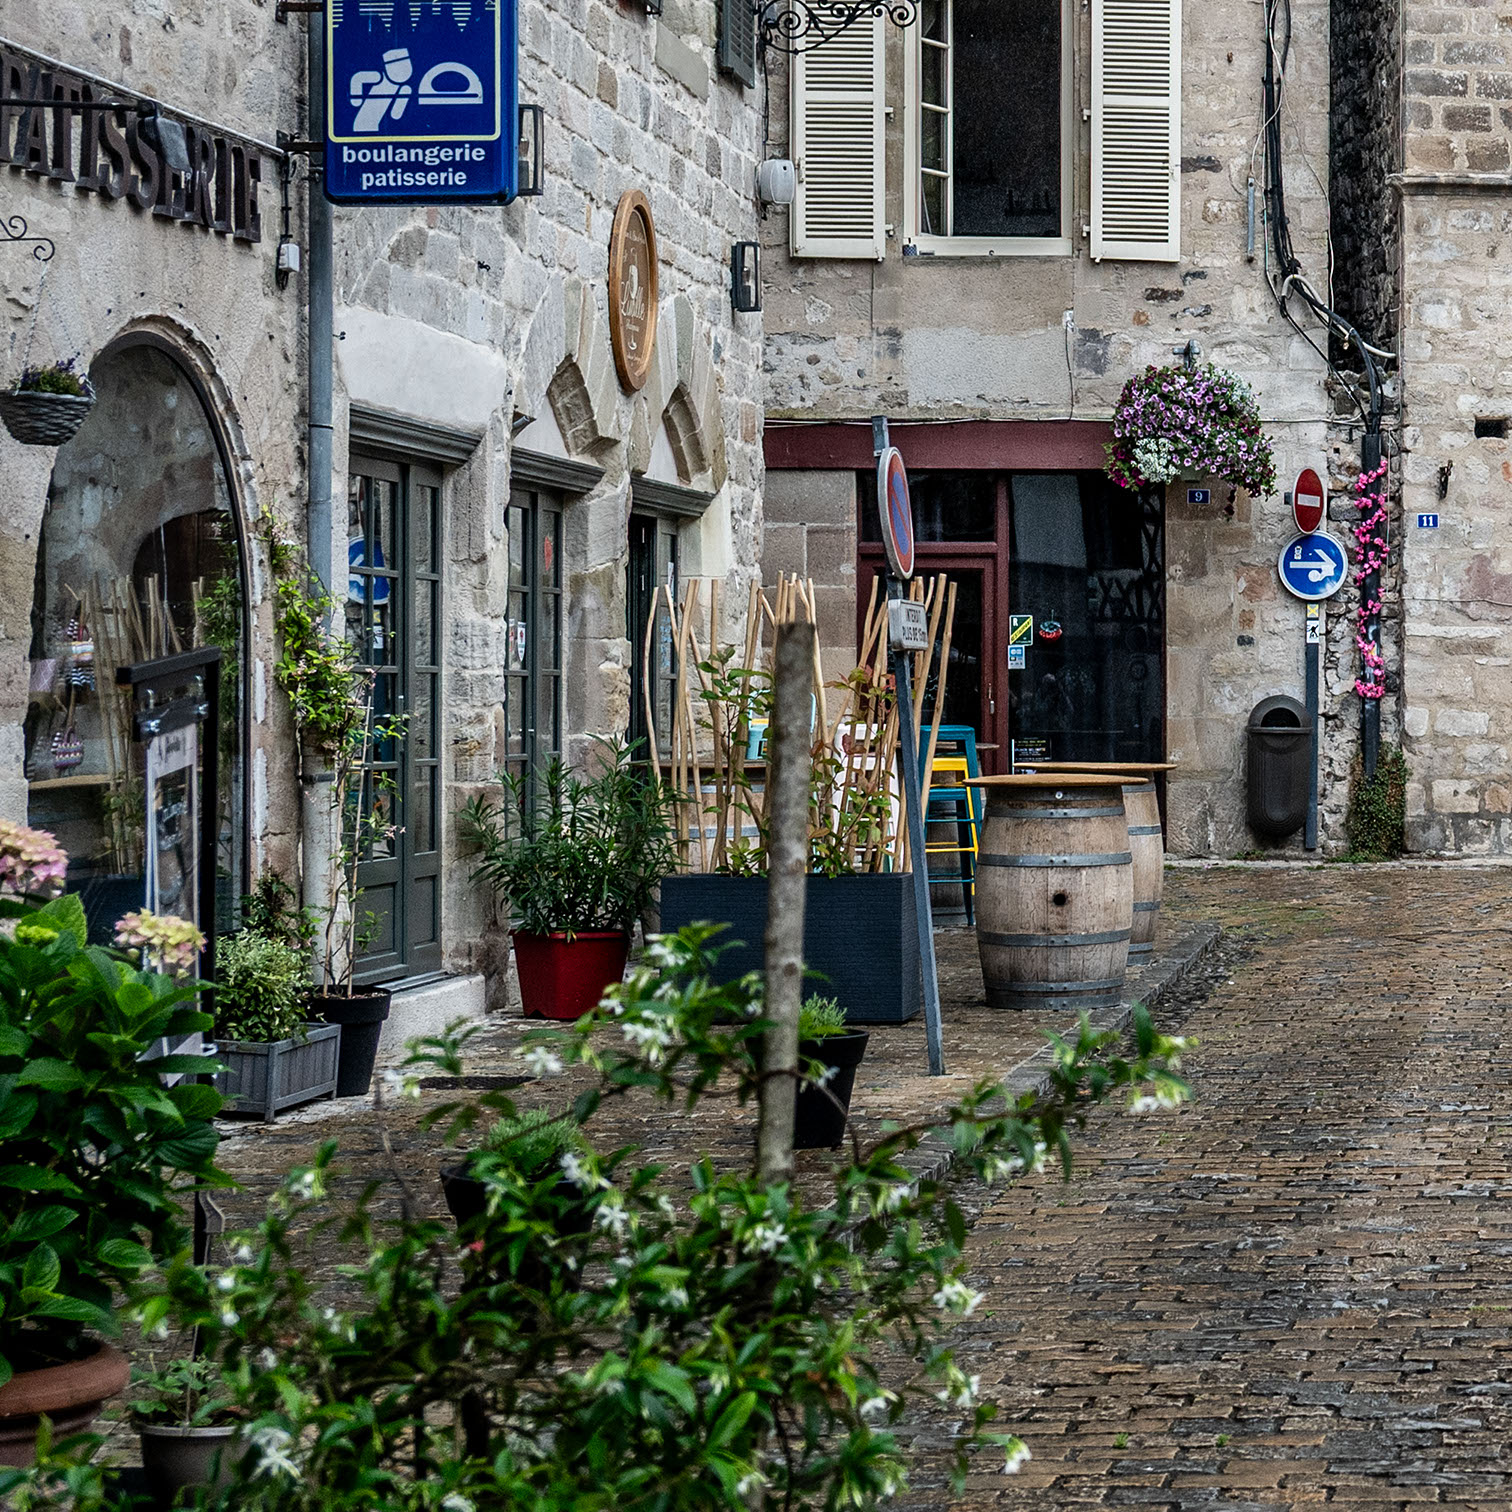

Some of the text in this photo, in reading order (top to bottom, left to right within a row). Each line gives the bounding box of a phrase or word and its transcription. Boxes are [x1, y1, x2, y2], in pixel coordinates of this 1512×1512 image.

[342, 144, 486, 166] boulangerie
[362, 168, 468, 191] patisserie
[1195, 491, 1203, 502] 9
[1422, 515, 1434, 527] 11
